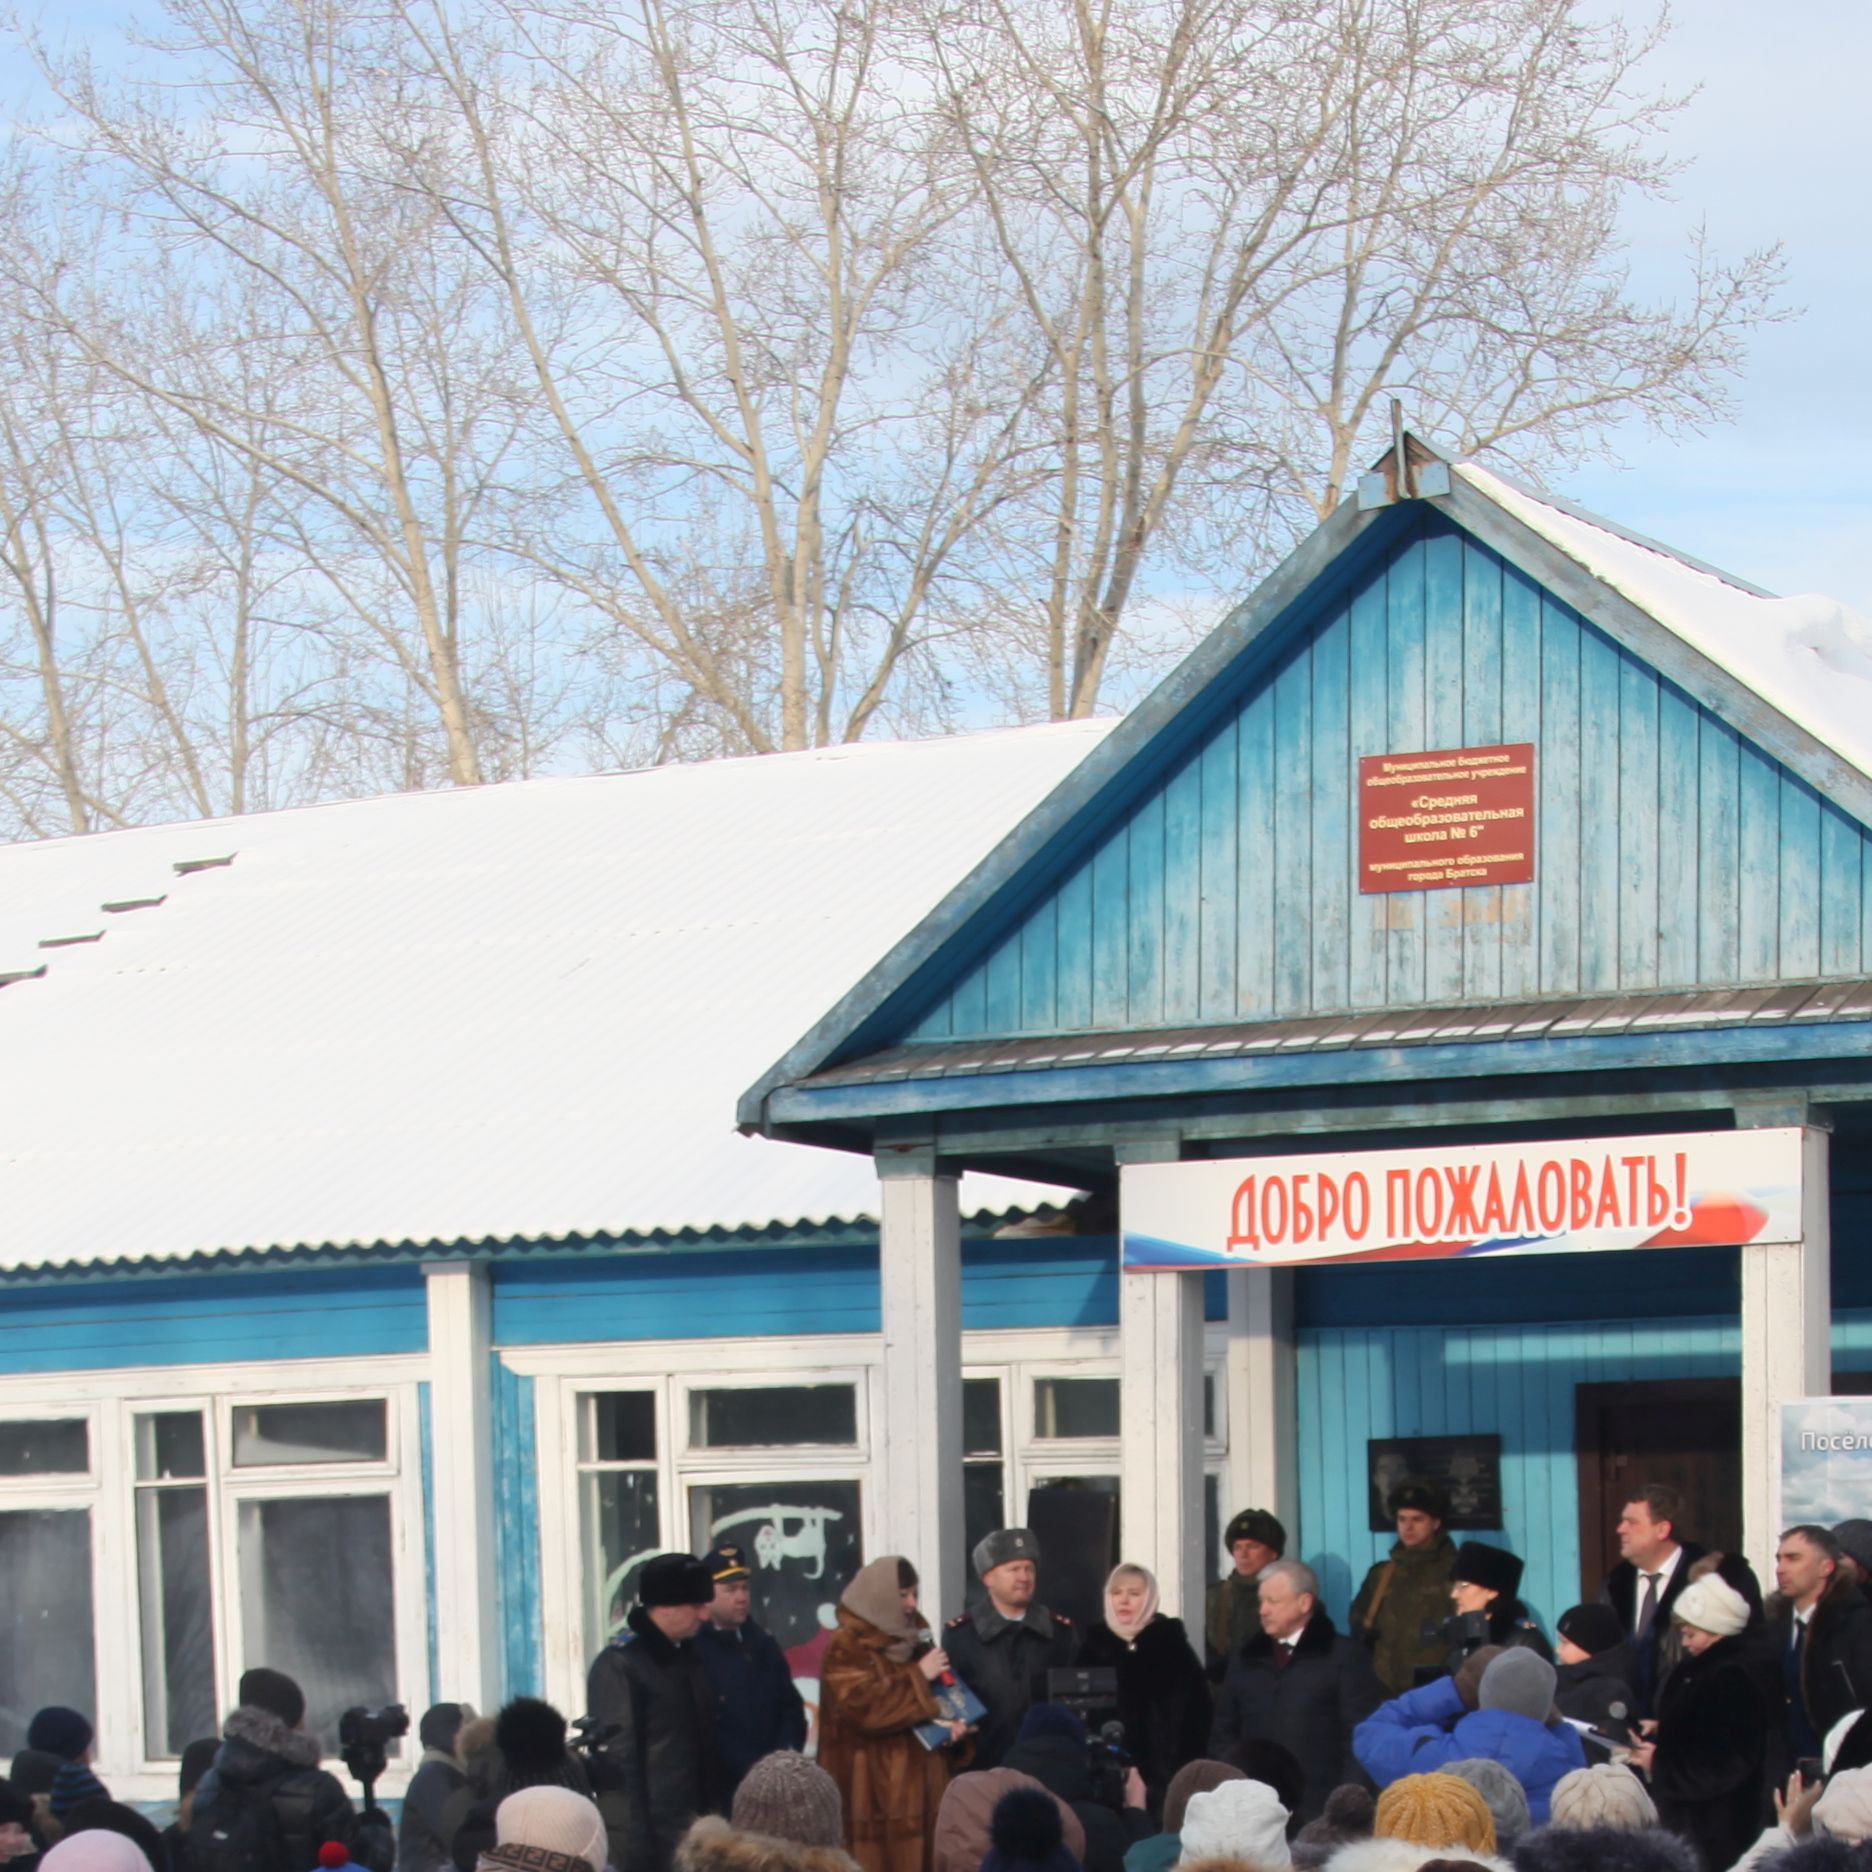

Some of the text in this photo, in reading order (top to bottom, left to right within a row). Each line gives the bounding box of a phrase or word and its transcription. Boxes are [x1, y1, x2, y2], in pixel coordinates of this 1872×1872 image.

[1458, 754, 1509, 767] бюджетное
[1366, 765, 1526, 786] общеобразовательное учреждение
[1411, 794, 1478, 810] «Средняя
[1369, 807, 1524, 829] общеобразовательная
[1405, 829, 1448, 843] школа
[1450, 827, 1467, 840] №
[1369, 852, 1524, 872] муниципального образования
[1407, 868, 1487, 882] города Братска
[1226, 1152, 1689, 1252] ДОБРО ПОЖАЛОВАТЬ!
